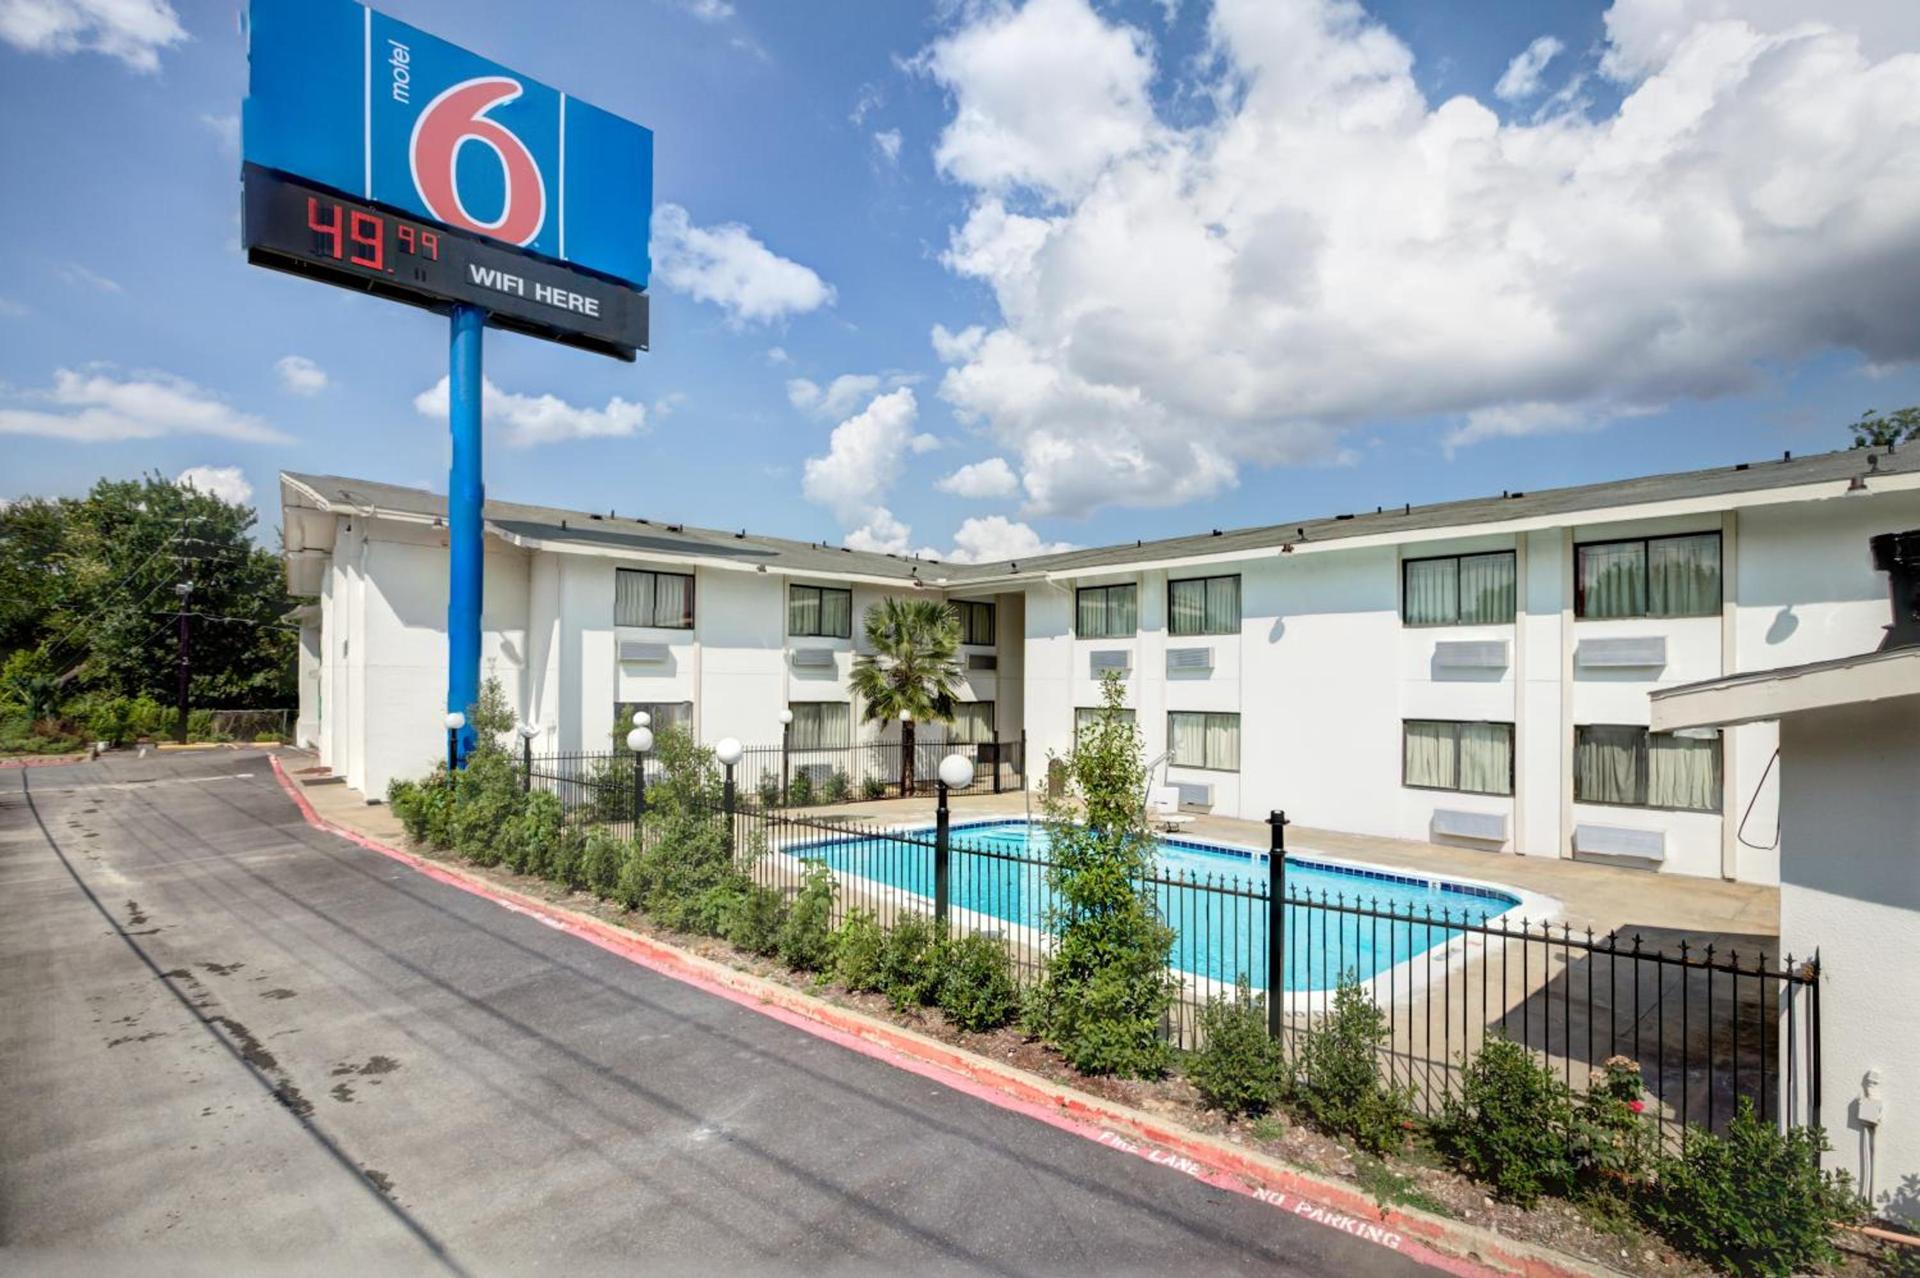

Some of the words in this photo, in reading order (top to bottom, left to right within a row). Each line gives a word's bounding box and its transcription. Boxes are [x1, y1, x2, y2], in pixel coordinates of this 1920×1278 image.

[388, 39, 410, 104] motel
[409, 76, 546, 247] 6
[470, 263, 524, 296] WIFI
[536, 282, 600, 317] HERE
[1149, 1150, 1200, 1175] LANE
[1252, 1187, 1286, 1206] NO
[1294, 1201, 1402, 1249] PARKING
